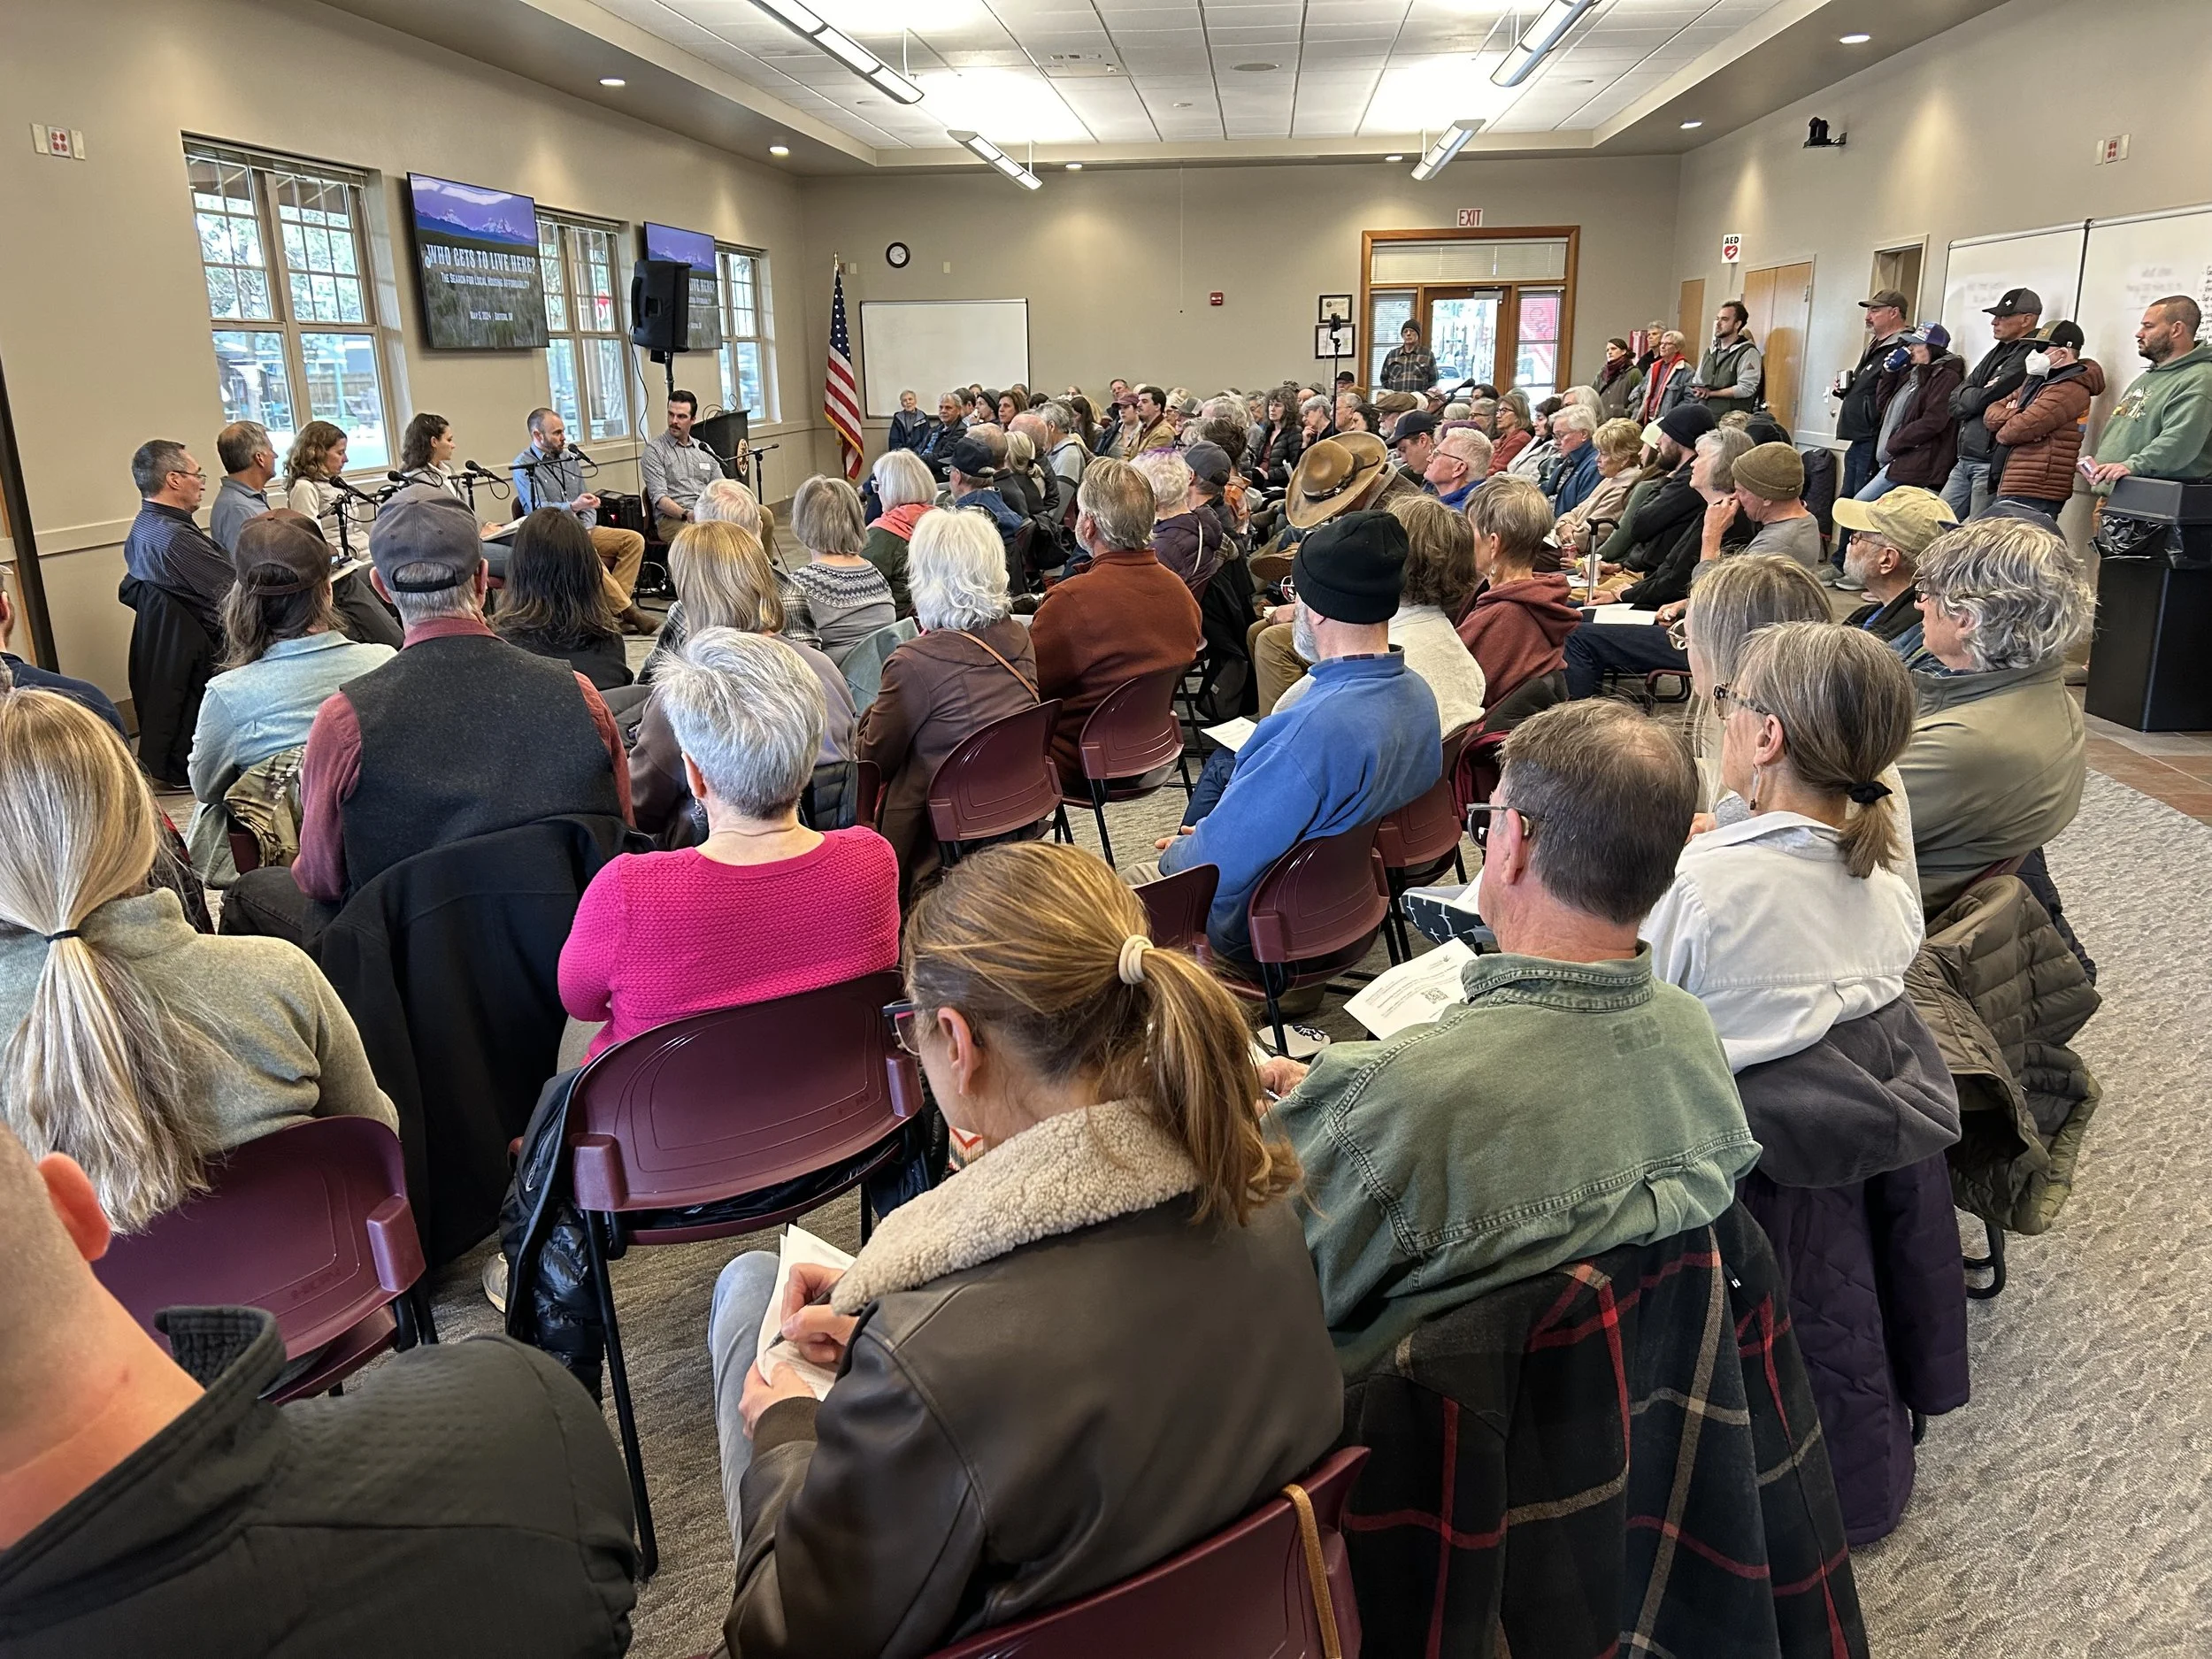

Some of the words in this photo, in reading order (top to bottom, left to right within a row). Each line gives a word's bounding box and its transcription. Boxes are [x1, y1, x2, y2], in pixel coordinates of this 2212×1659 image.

[1459, 210, 1481, 226] EXIT
[425, 244, 451, 268] WHO
[453, 248, 475, 269] GETS
[476, 250, 488, 269] TO
[489, 252, 510, 272] LIVE
[510, 255, 536, 275] HERE?
